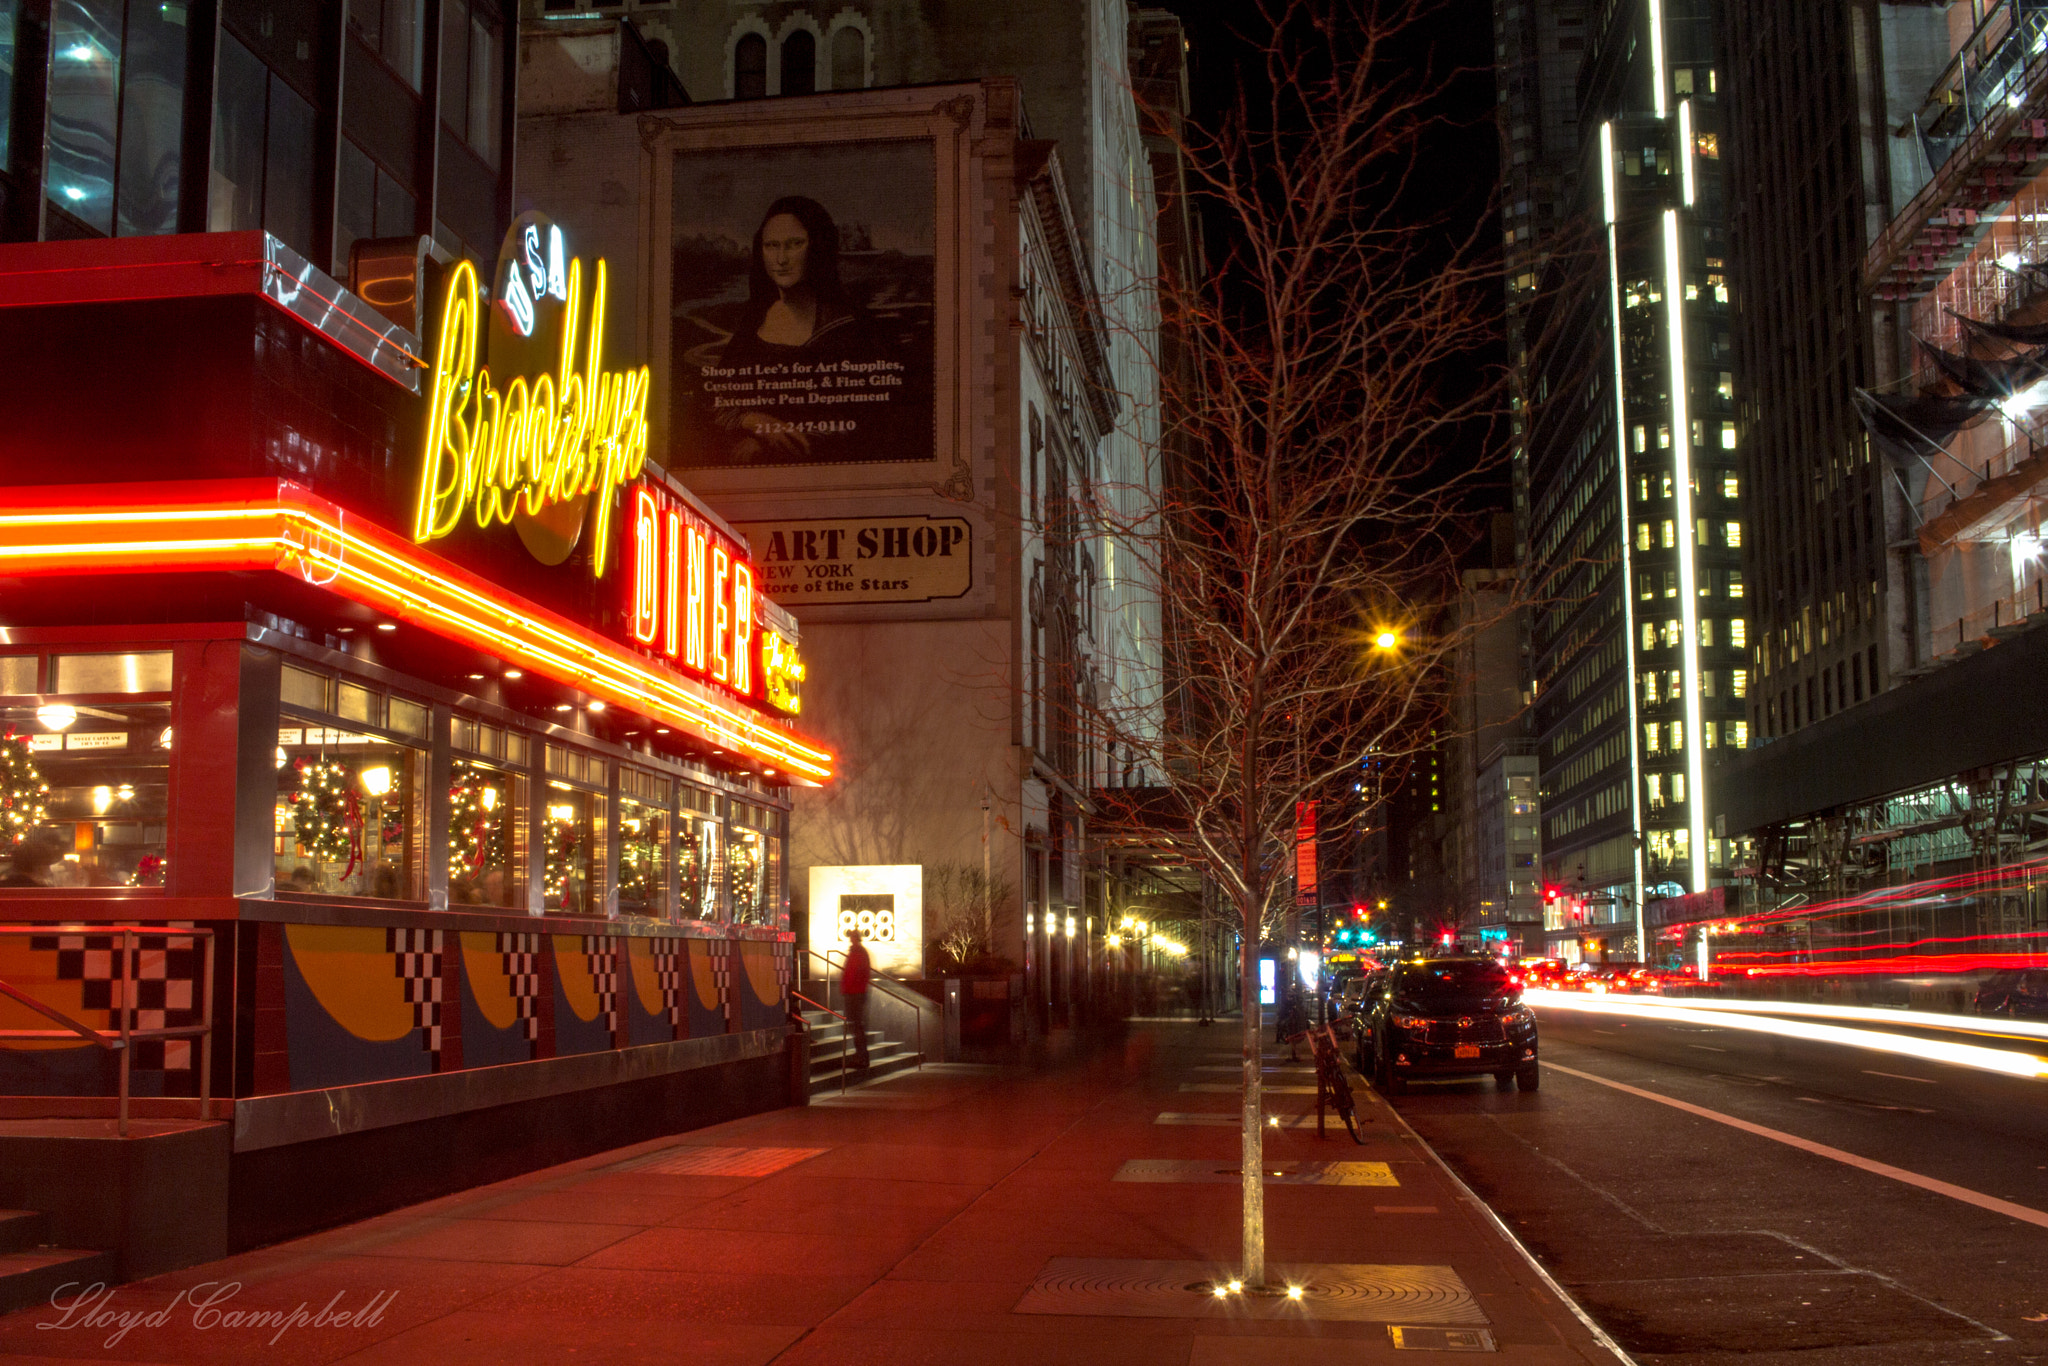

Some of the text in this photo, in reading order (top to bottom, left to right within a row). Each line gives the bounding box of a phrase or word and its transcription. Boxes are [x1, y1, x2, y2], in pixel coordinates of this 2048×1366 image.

[505, 224, 567, 337] USA
[701, 359, 905, 378] Shop at Lee's for Art Supplies,
[703, 374, 903, 392] Custom Framing, & Fine Gifts
[714, 391, 890, 408] Extensive Pen Department
[415, 257, 650, 578] Brooklyn
[755, 420, 857, 434] 212-247-0110
[763, 528, 845, 562] ART
[857, 525, 964, 560] SHOP
[752, 564, 854, 580] NEW YORK
[635, 489, 753, 696] DINER
[804, 580, 824, 592] of
[825, 579, 854, 592] the
[860, 578, 909, 591] Stars
